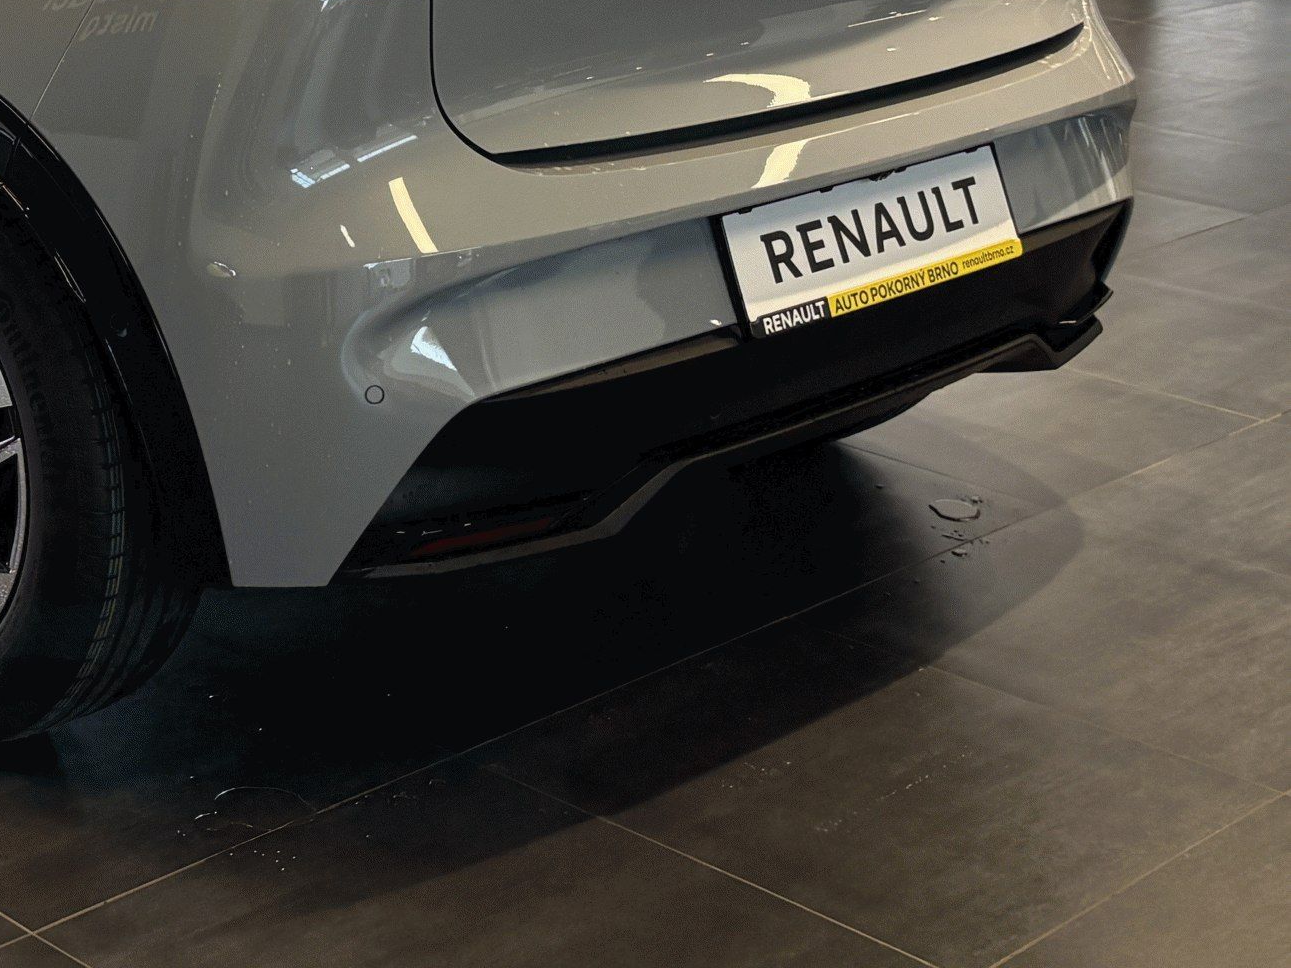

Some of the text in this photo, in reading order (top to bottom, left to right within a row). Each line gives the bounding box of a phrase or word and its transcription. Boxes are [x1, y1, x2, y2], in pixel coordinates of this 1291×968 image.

[760, 176, 980, 284] RENAULT
[763, 243, 1015, 335] RENAULT AUTO POKORNÝ BRNO renaultbrno.cz
